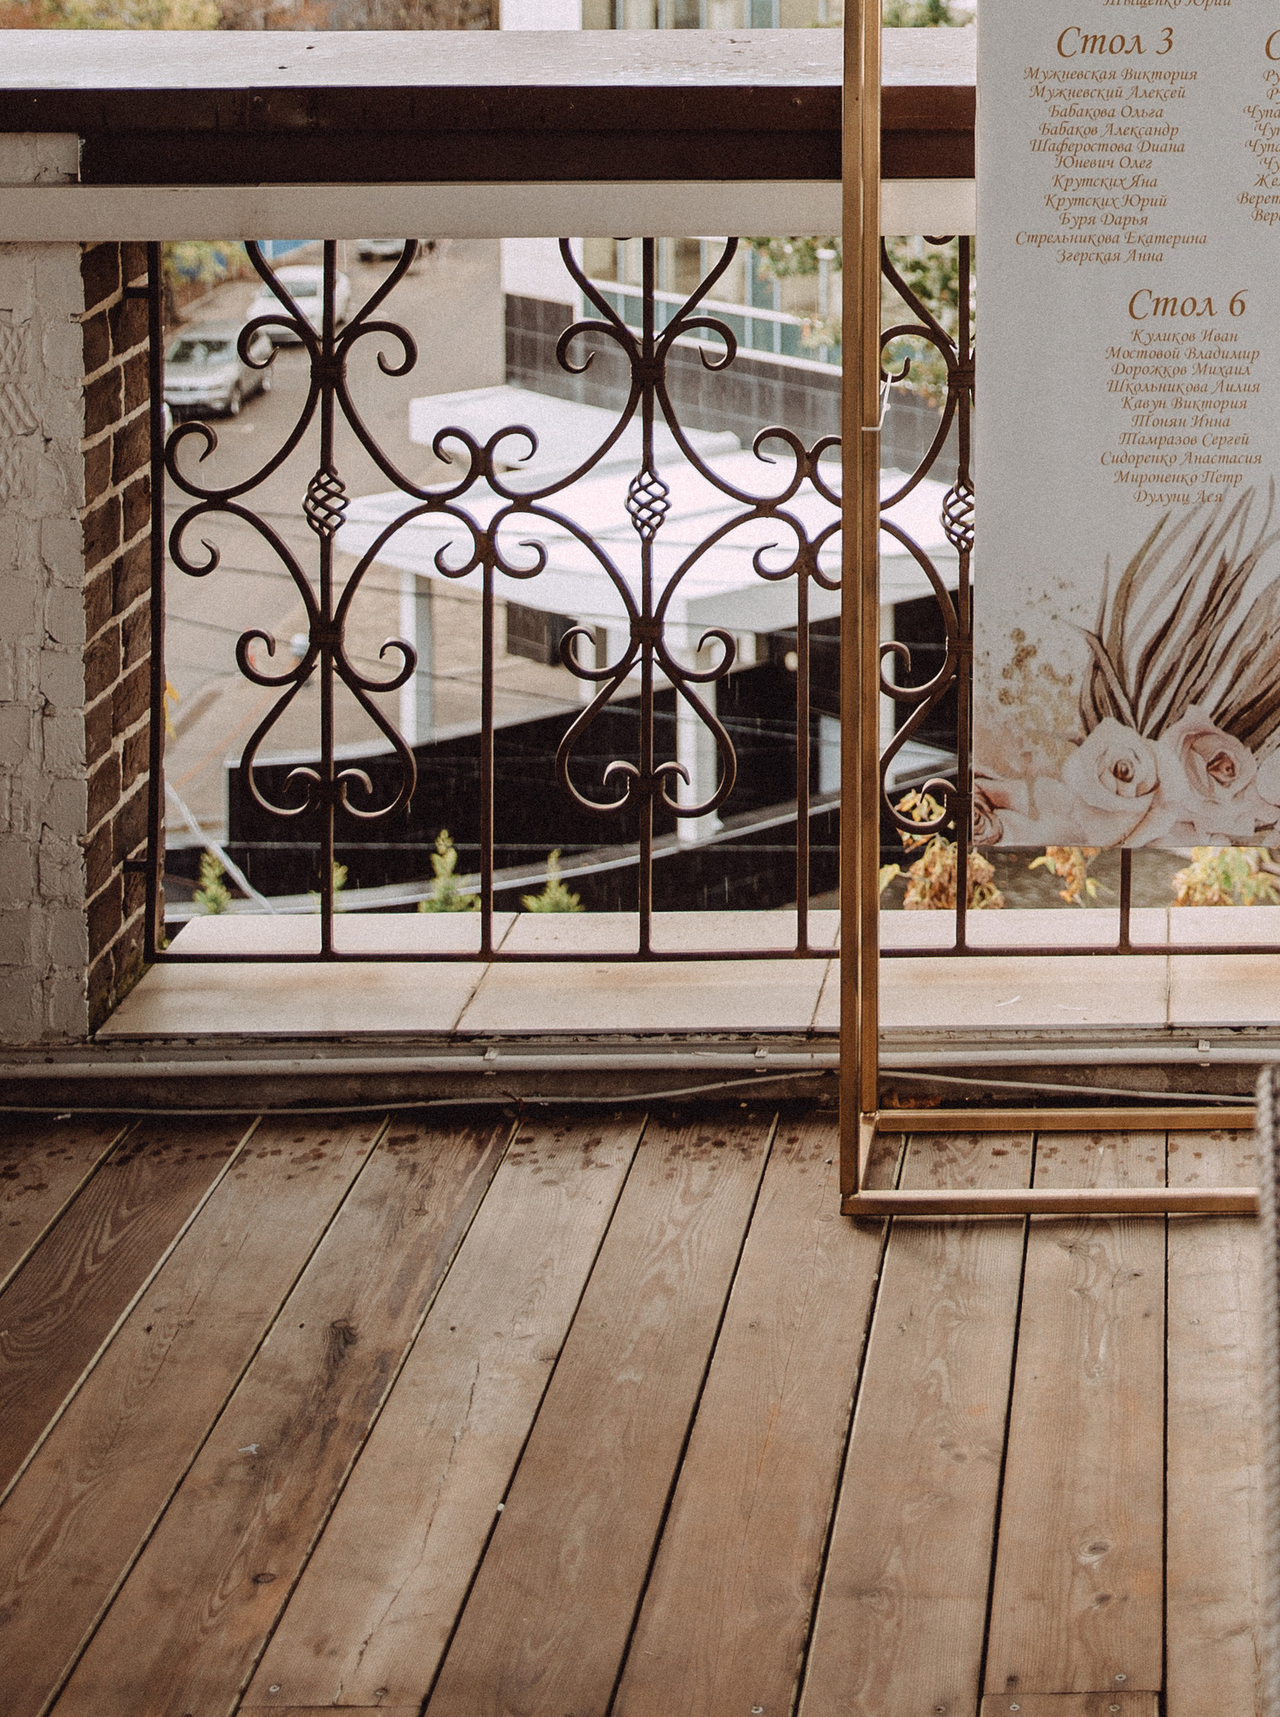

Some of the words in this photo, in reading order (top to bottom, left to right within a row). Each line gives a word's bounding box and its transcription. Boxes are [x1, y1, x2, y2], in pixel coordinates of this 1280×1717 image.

[1057, 26, 1146, 58] Стол
[1156, 27, 1173, 55] 3
[1024, 67, 1116, 83] Мужневская
[1121, 69, 1197, 85] Виктория
[1030, 85, 1122, 102] Мужневский
[1125, 86, 1185, 100] Алексей
[1049, 104, 1115, 120] Бабакова
[1121, 106, 1163, 118] Ольга
[1039, 121, 1097, 139] Бабаков
[1101, 123, 1179, 140] Александр
[1137, 141, 1185, 152] Диана
[1055, 156, 1114, 168] Юневич
[1120, 157, 1152, 169] Олег
[1052, 175, 1124, 191] Крутских
[1126, 175, 1157, 188] Яна
[1044, 194, 1119, 211] Крутских
[1122, 195, 1166, 211] Юрий
[1059, 213, 1095, 229] Буря
[1100, 214, 1148, 230] Дарья
[1016, 232, 1119, 248] Стрельникова
[1124, 232, 1207, 249] Екатерина
[1124, 249, 1163, 262] Анна
[1128, 289, 1217, 321] Стол
[1229, 289, 1248, 317] 6
[1131, 330, 1195, 346] Куликов
[1200, 329, 1238, 342] Иван
[1105, 347, 1179, 359] Мостовой
[1185, 346, 1260, 364] Владимир
[1111, 364, 1186, 379] Дорожков
[1192, 363, 1250, 376] Михаил
[1106, 380, 1207, 394] Школьникова
[1211, 380, 1260, 392] Лилия
[1121, 397, 1165, 413] Кавун
[1171, 398, 1247, 413] Виктория
[1131, 415, 1186, 427] Тонян
[1191, 416, 1230, 427] Инна
[1118, 433, 1197, 449] Тамразов
[1202, 432, 1249, 449] Сергей
[1101, 450, 1177, 468] Сидоренко
[1180, 452, 1262, 464] Анастасия
[1114, 471, 1198, 487] Мироненко
[1201, 471, 1242, 487] Петр
